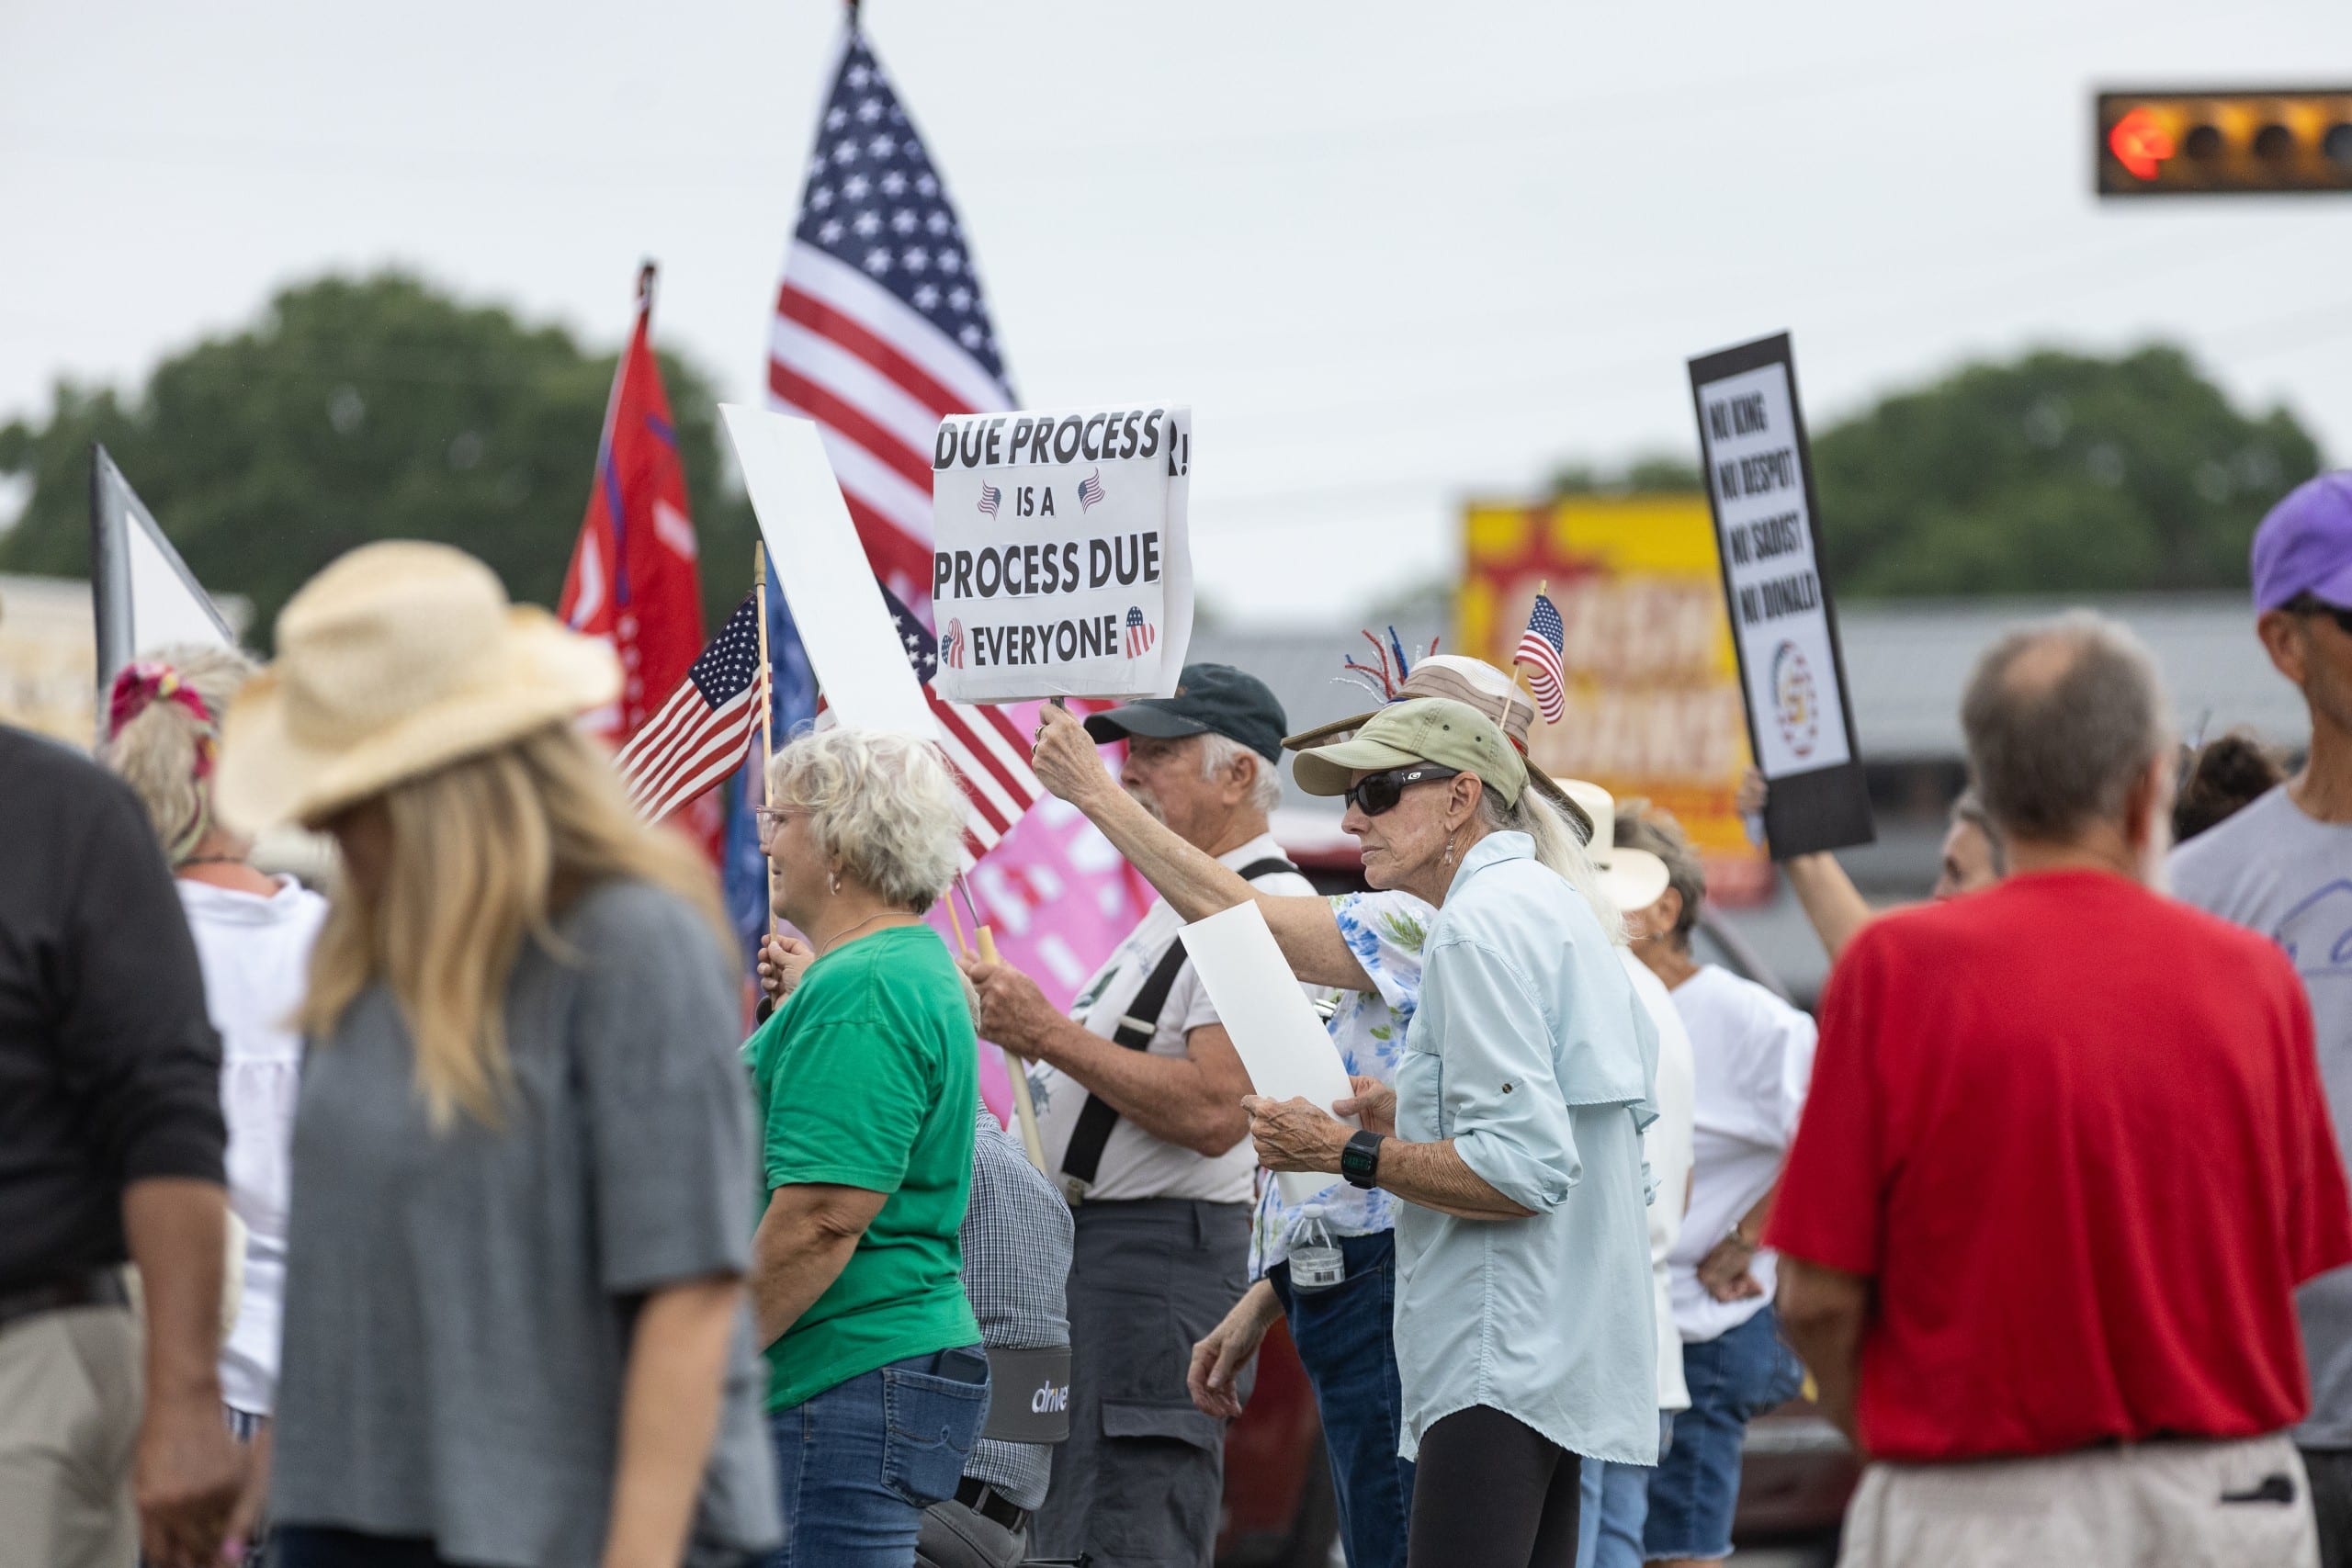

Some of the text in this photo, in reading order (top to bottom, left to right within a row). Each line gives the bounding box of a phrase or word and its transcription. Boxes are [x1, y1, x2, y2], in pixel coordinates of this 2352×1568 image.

[933, 408, 1165, 469] DUE PROCESS
[1741, 448, 1796, 495] DESPOT
[1016, 486, 1055, 517] IS A
[933, 531, 1160, 600] PROCESS DUE
[1760, 571, 1819, 619] DONALD
[971, 615, 1118, 666] EVERYONE
[1031, 1380, 1069, 1413] drive
